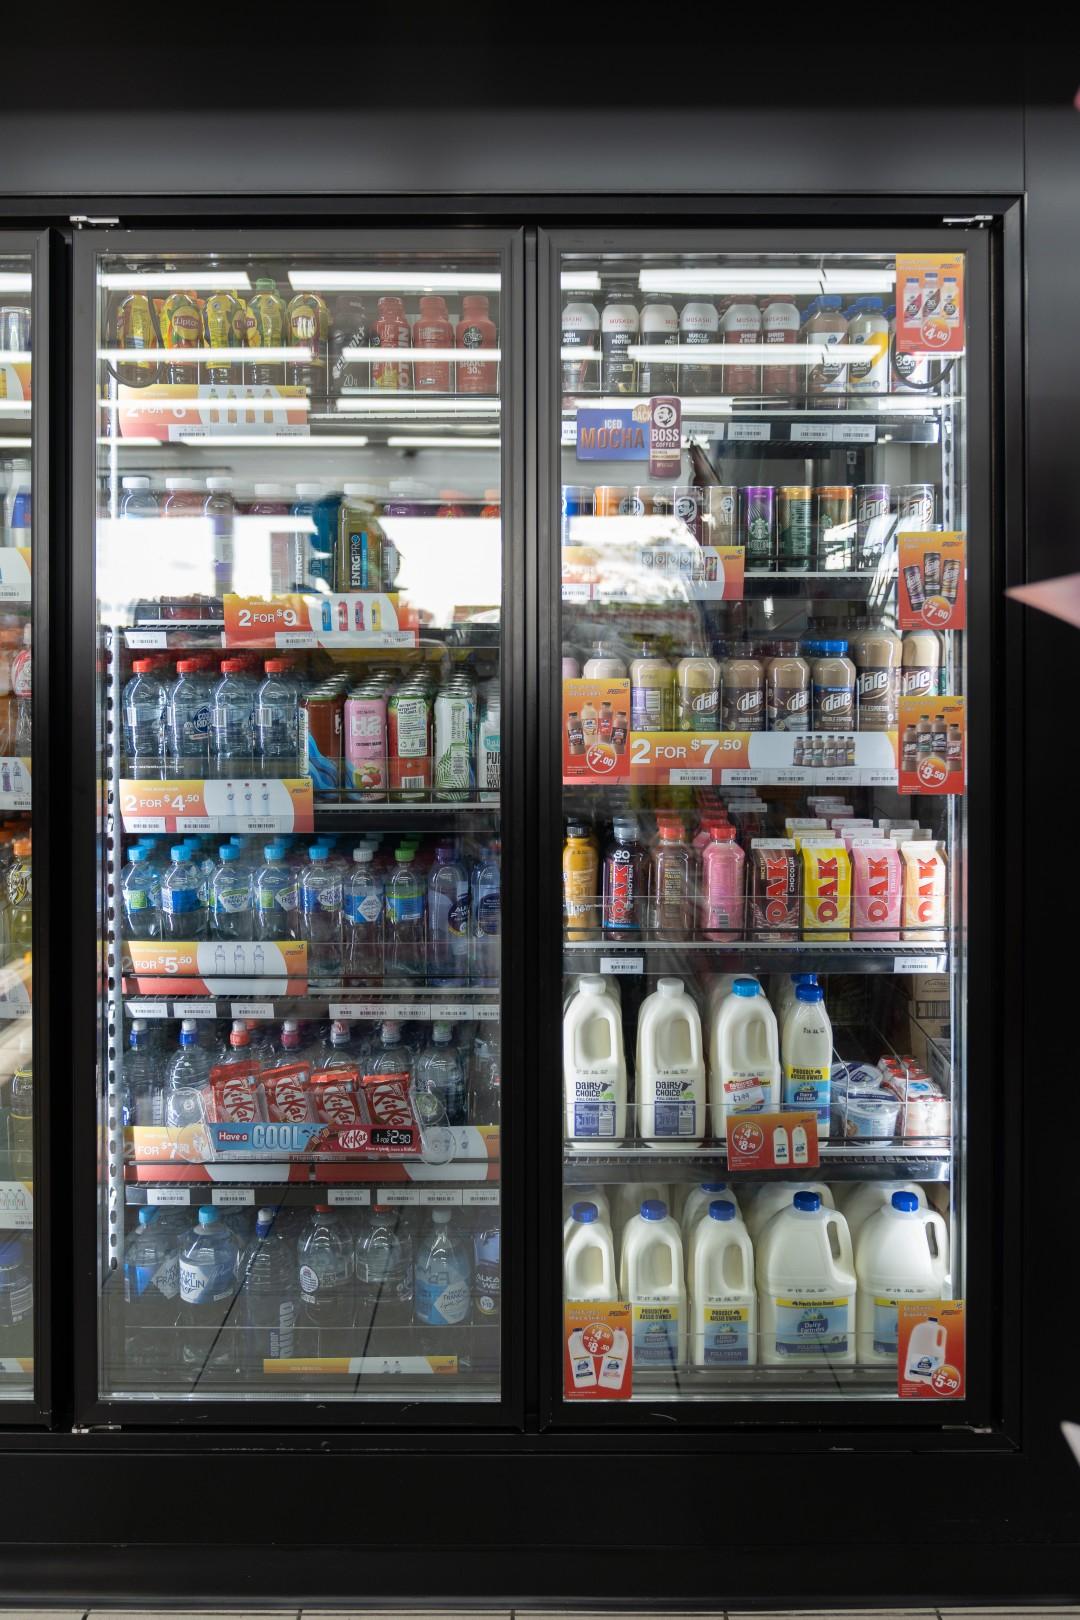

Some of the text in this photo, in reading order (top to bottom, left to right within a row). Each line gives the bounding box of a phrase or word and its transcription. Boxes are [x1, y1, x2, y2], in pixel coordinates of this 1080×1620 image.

[604, 420, 622, 429] ICED
[580, 427, 645, 449] MOCHA
[652, 429, 679, 442] BOSS
[238, 609, 297, 626] 2 FOR $9
[857, 671, 888, 695] dare
[791, 690, 809, 711] da
[825, 692, 851, 711] dare
[631, 738, 742, 764] 2 FOR $7.50
[125, 794, 200, 811] 2 FOR $4.50
[613, 850, 630, 860] 30
[612, 864, 629, 918] OAK
[766, 857, 788, 923] OAK
[817, 857, 838, 923] OAK
[867, 857, 889, 922] OAK
[917, 857, 938, 922] OAK
[135, 961, 157, 969] FOR
[276, 1080, 309, 1122] KitKat
[373, 1090, 412, 1125] KitKa
[218, 1131, 241, 1141] Have
[252, 1125, 300, 1149] COOL
[341, 1130, 368, 1149] KitKat
[138, 1145, 160, 1155] FOR
